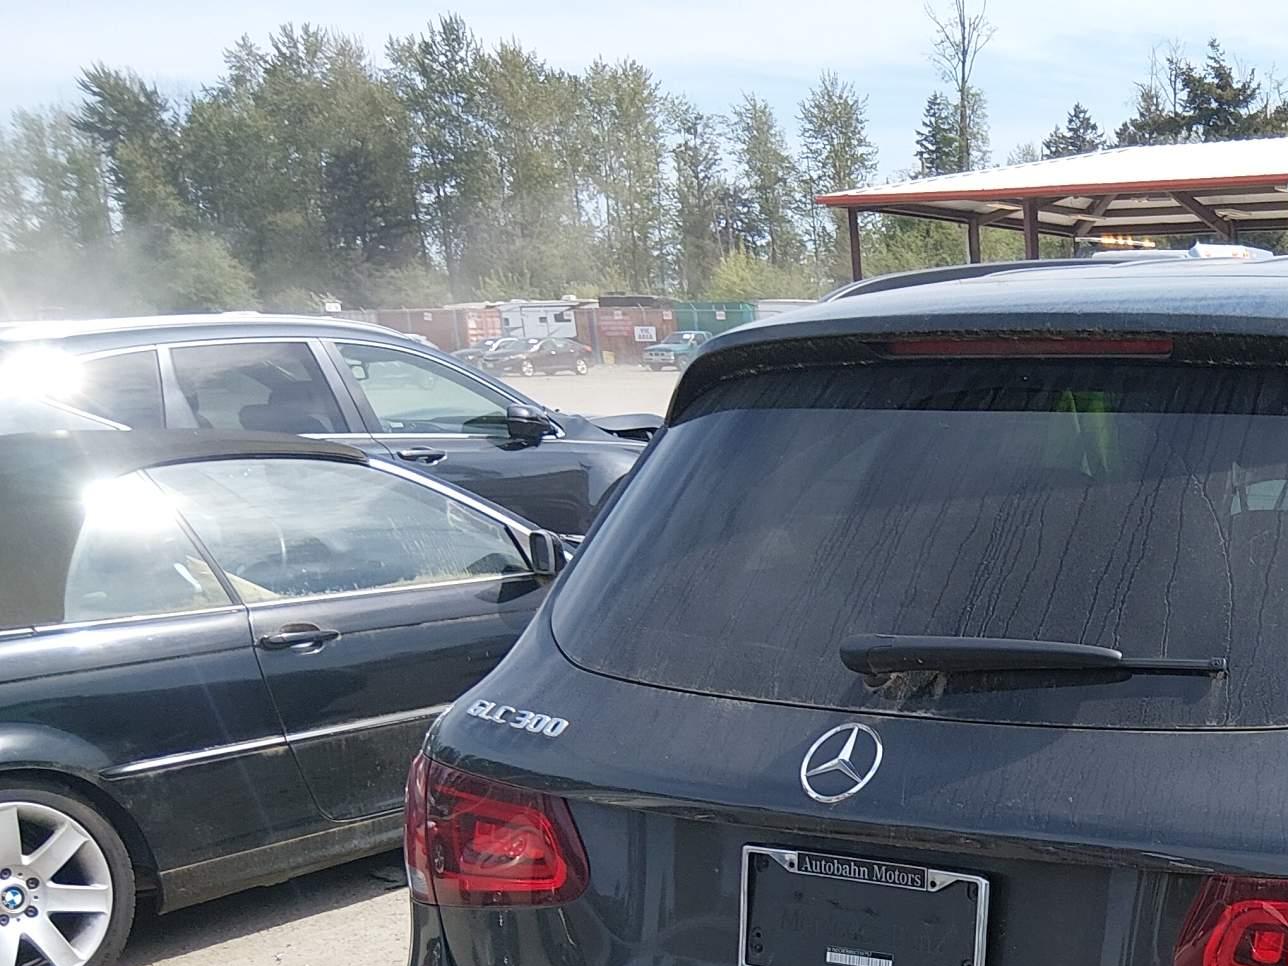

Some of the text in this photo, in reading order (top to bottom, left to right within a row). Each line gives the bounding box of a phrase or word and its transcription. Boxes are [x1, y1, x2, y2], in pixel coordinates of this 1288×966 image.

[467, 700, 569, 737] GLC 300
[801, 857, 921, 887] Autobahn Motors
